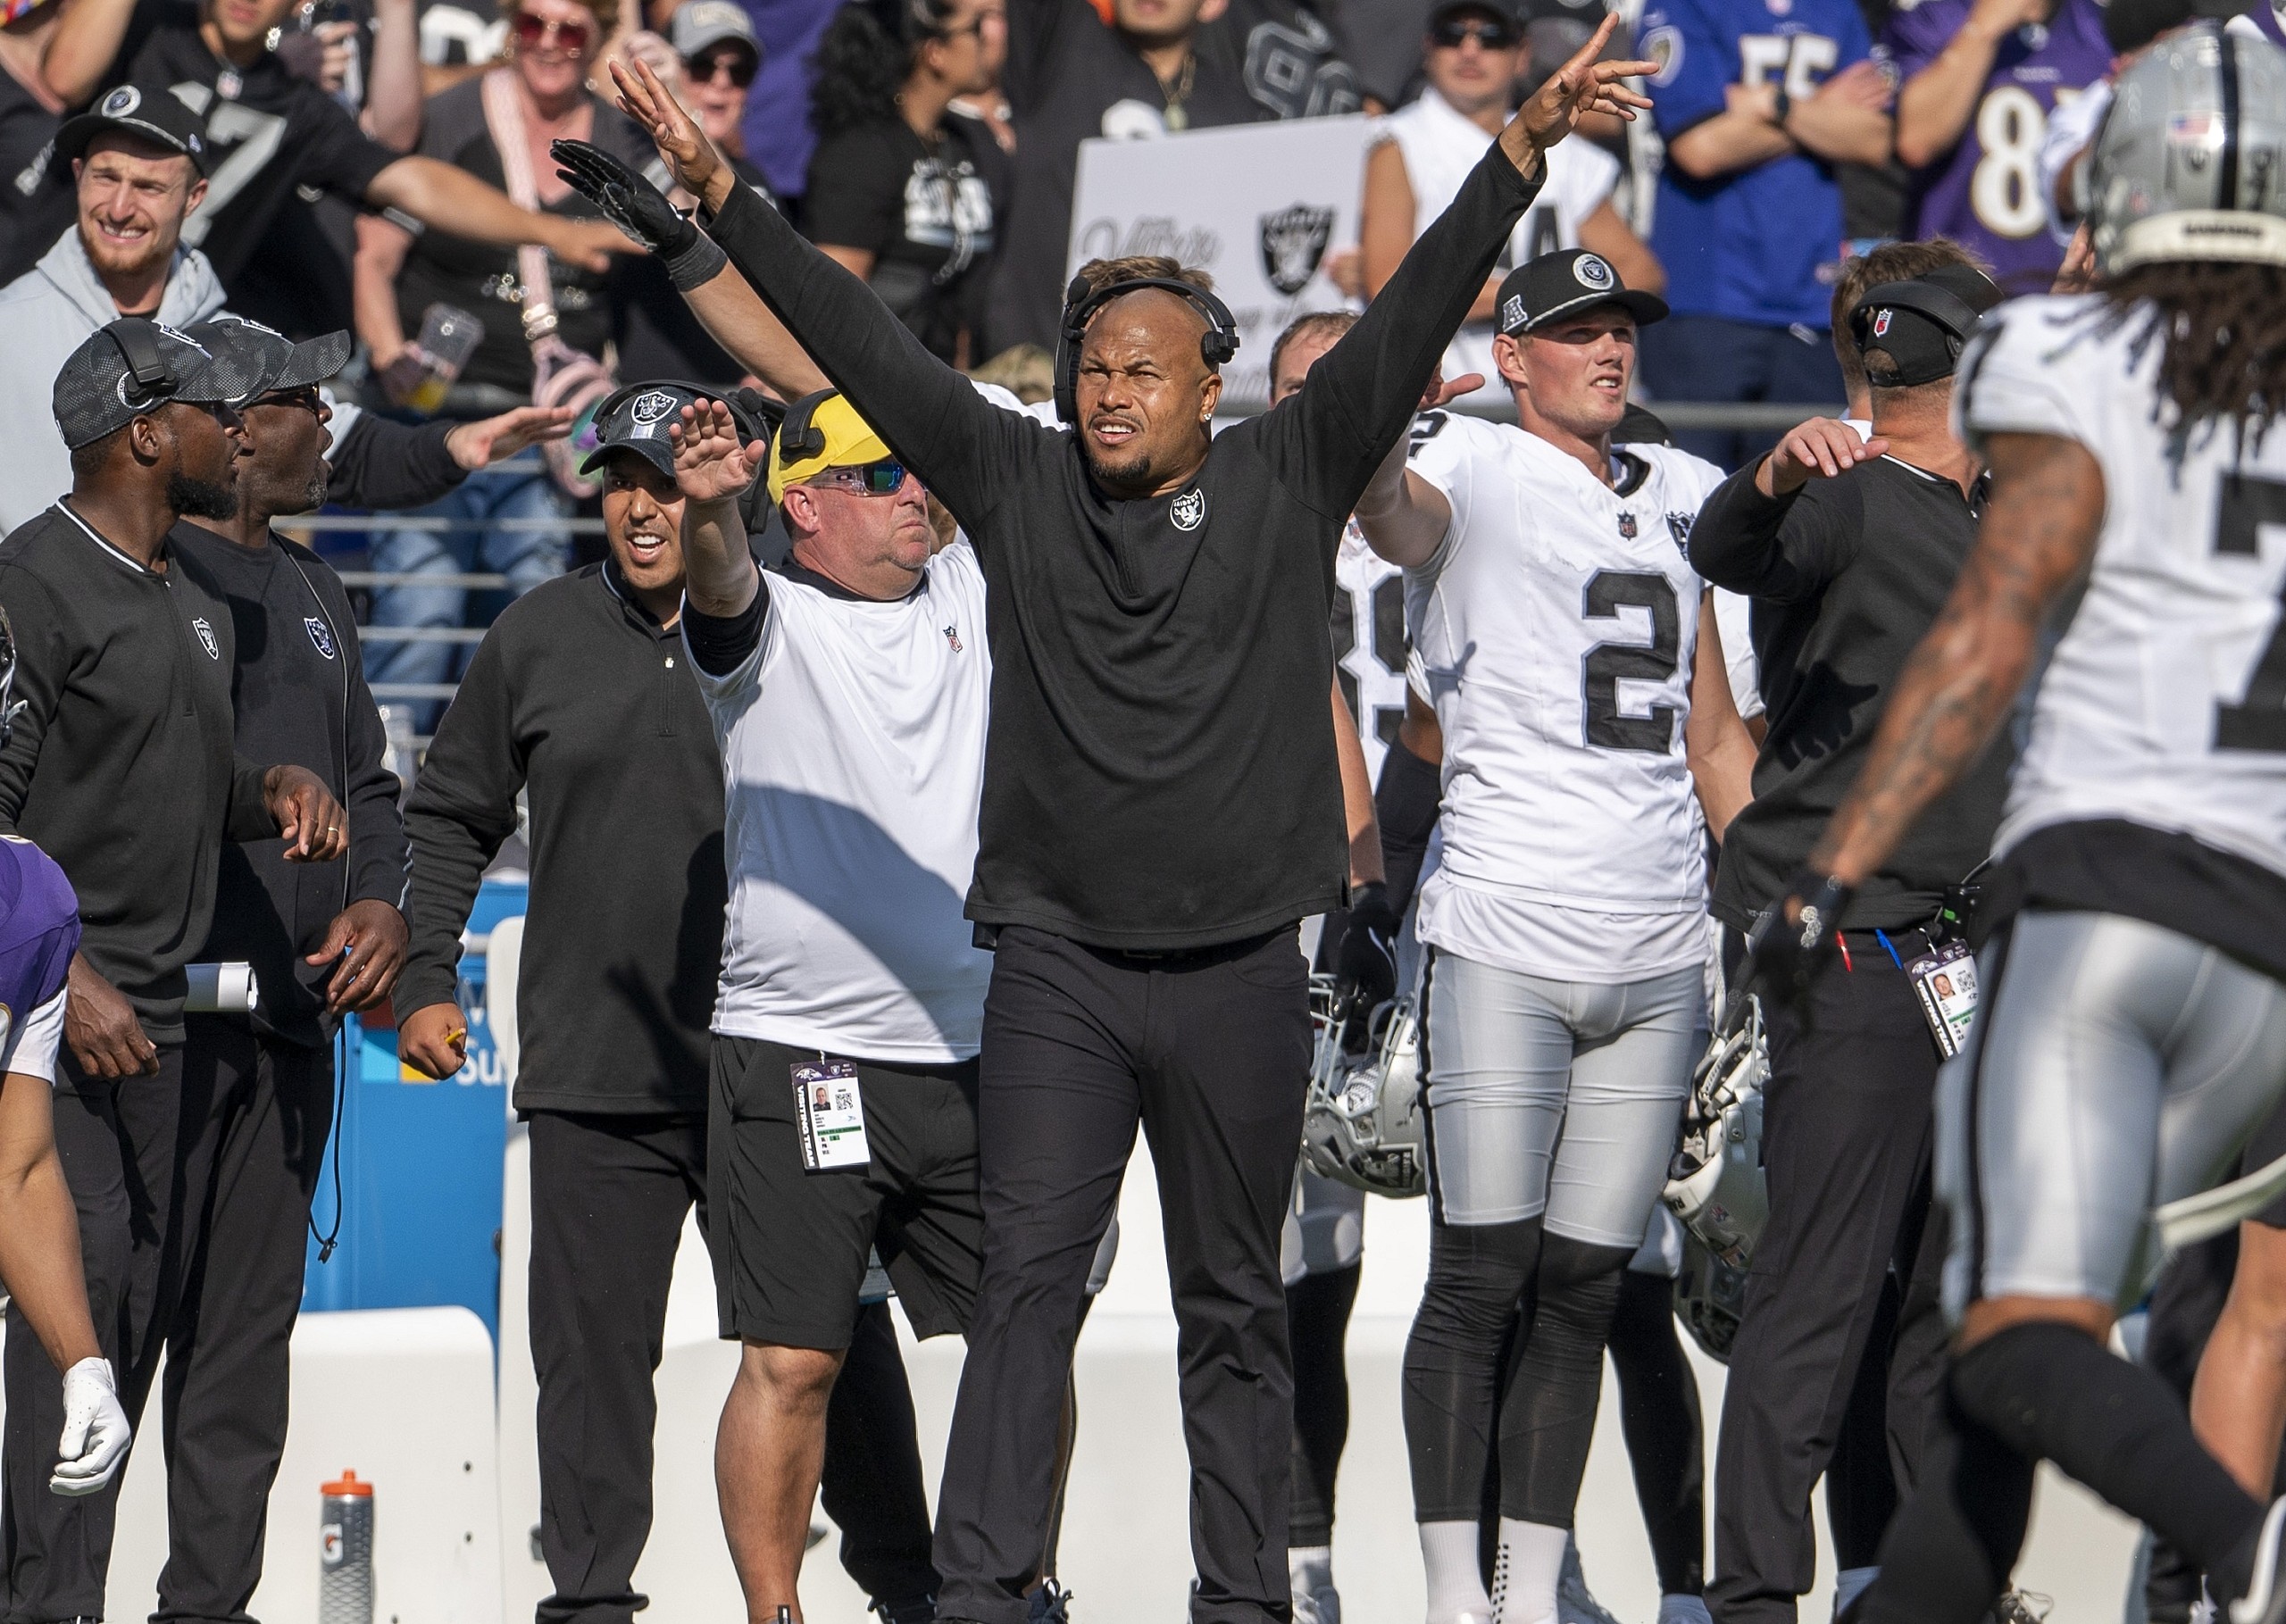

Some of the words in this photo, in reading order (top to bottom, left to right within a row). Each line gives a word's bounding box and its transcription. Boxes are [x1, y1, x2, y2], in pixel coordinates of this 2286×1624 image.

[1581, 566, 1681, 754] 2
[1916, 979, 1940, 1027] VISITING
[1937, 1025, 1954, 1057] TEAM
[797, 1085, 810, 1135] VISITING
[804, 1135, 815, 1167] TEAM
[321, 1522, 344, 1563] G
